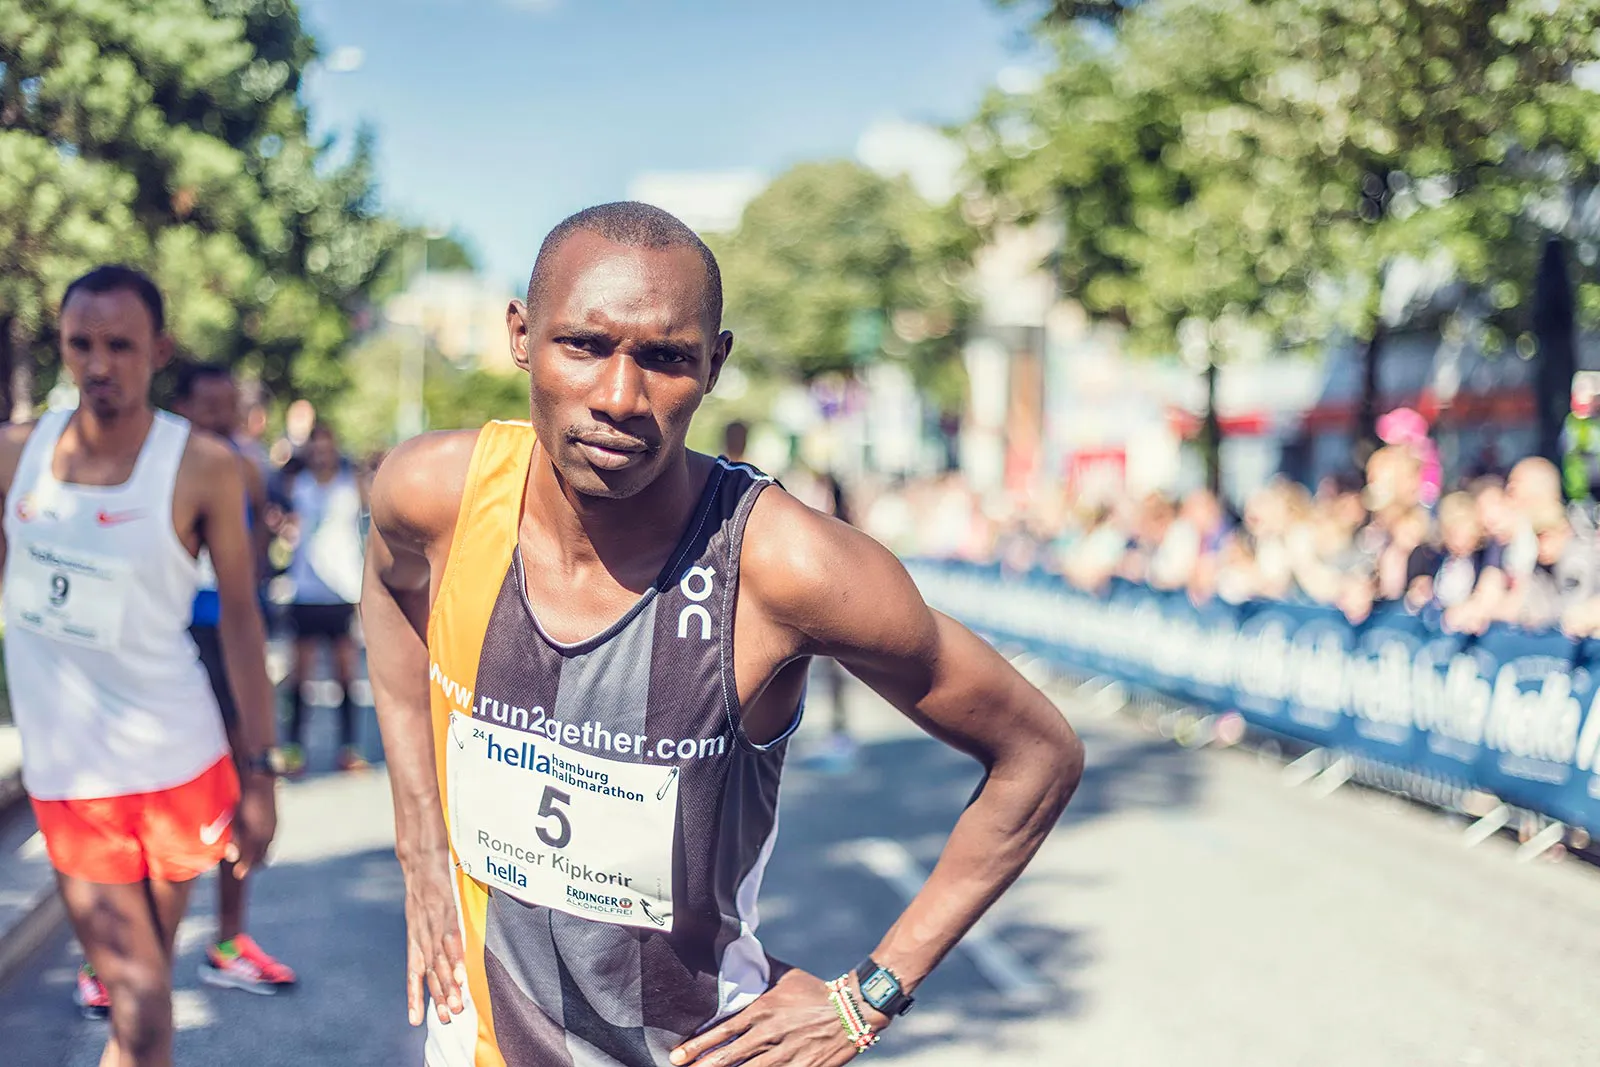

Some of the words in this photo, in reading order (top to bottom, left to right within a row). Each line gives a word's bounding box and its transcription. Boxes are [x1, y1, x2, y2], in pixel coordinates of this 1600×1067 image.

[50, 573, 69, 607] 9
[487, 733, 551, 775] hella
[552, 754, 609, 785] hamburg
[552, 767, 644, 802] halbmarathon
[535, 785, 572, 849] 5
[478, 829, 545, 866] Roncer
[552, 852, 633, 888] Kipkorir
[486, 855, 527, 888] hella
[566, 885, 619, 907] ERDINGER
[566, 899, 632, 916] ALKOHOLFREI
